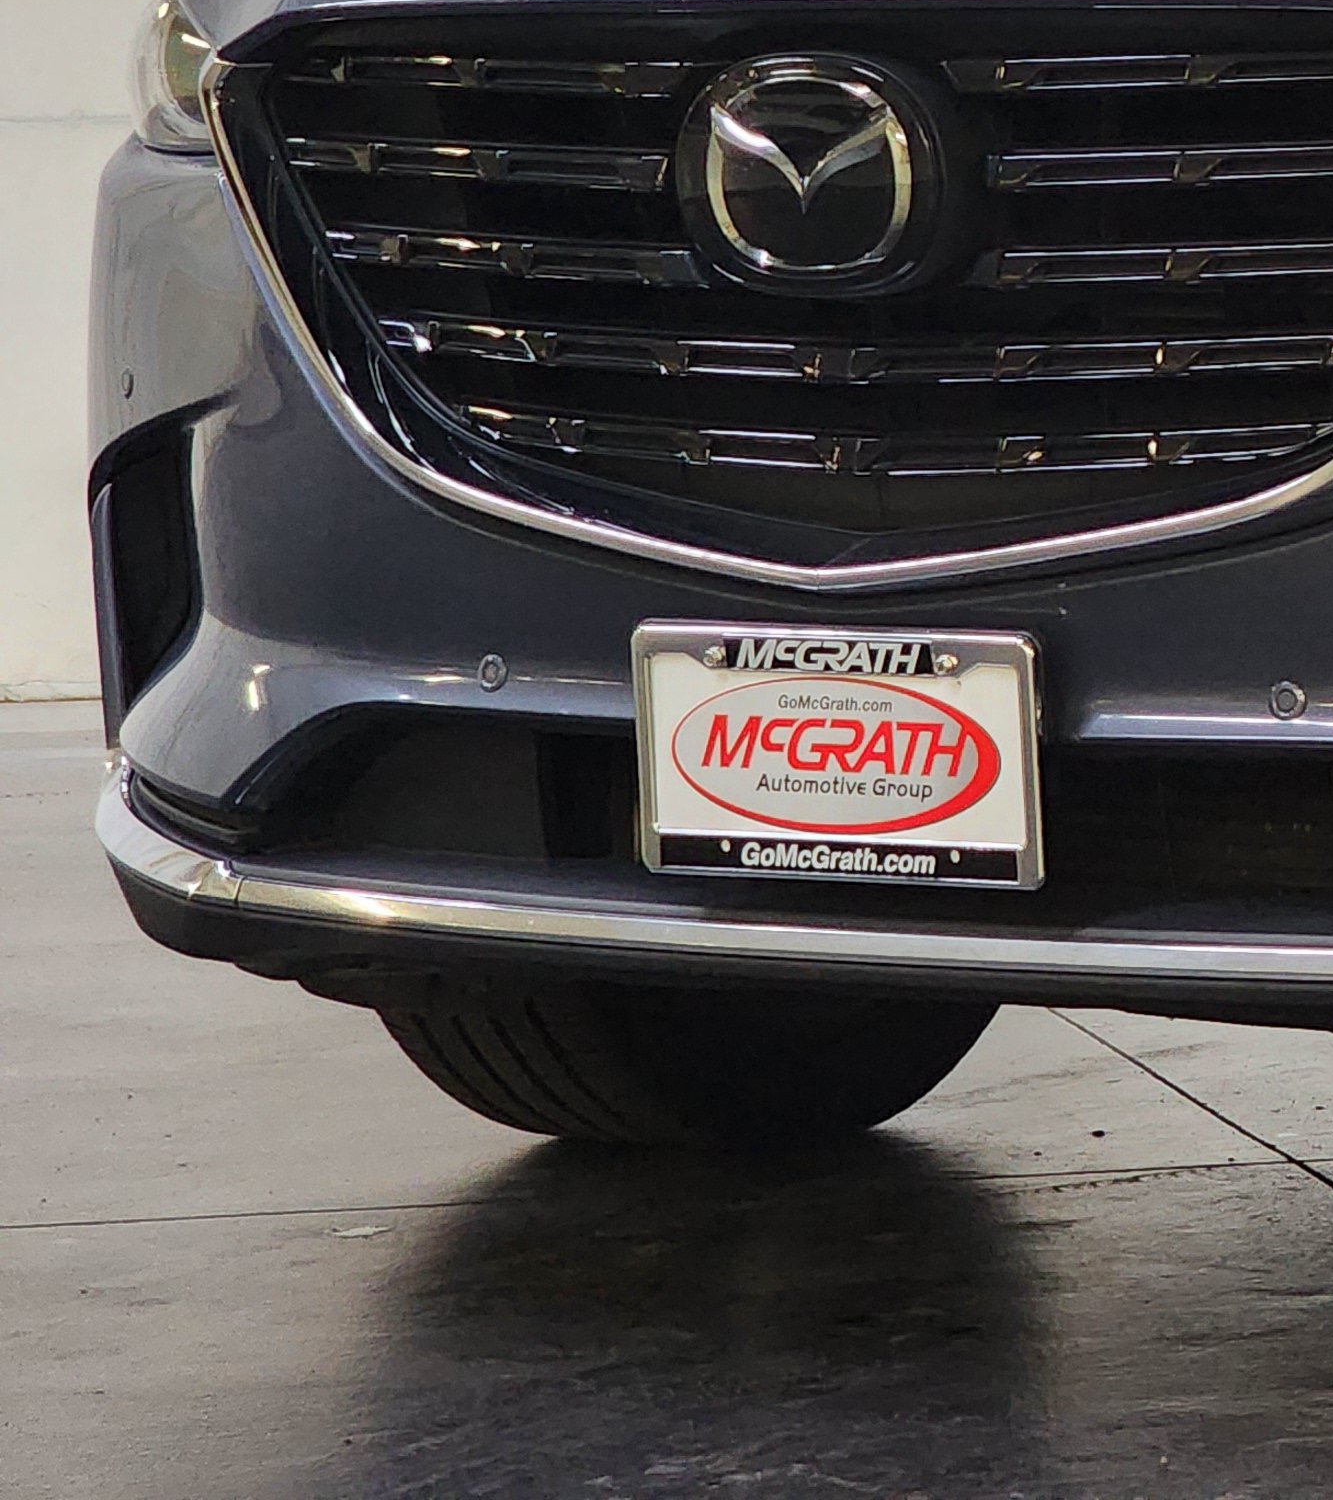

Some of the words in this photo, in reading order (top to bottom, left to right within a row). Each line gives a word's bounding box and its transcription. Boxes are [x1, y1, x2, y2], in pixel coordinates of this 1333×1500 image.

[777, 693, 893, 713] GoMcGrath.com
[756, 773, 867, 797] Automotive
[872, 778, 934, 803] Group
[740, 841, 937, 876] GoMcGrath.com
